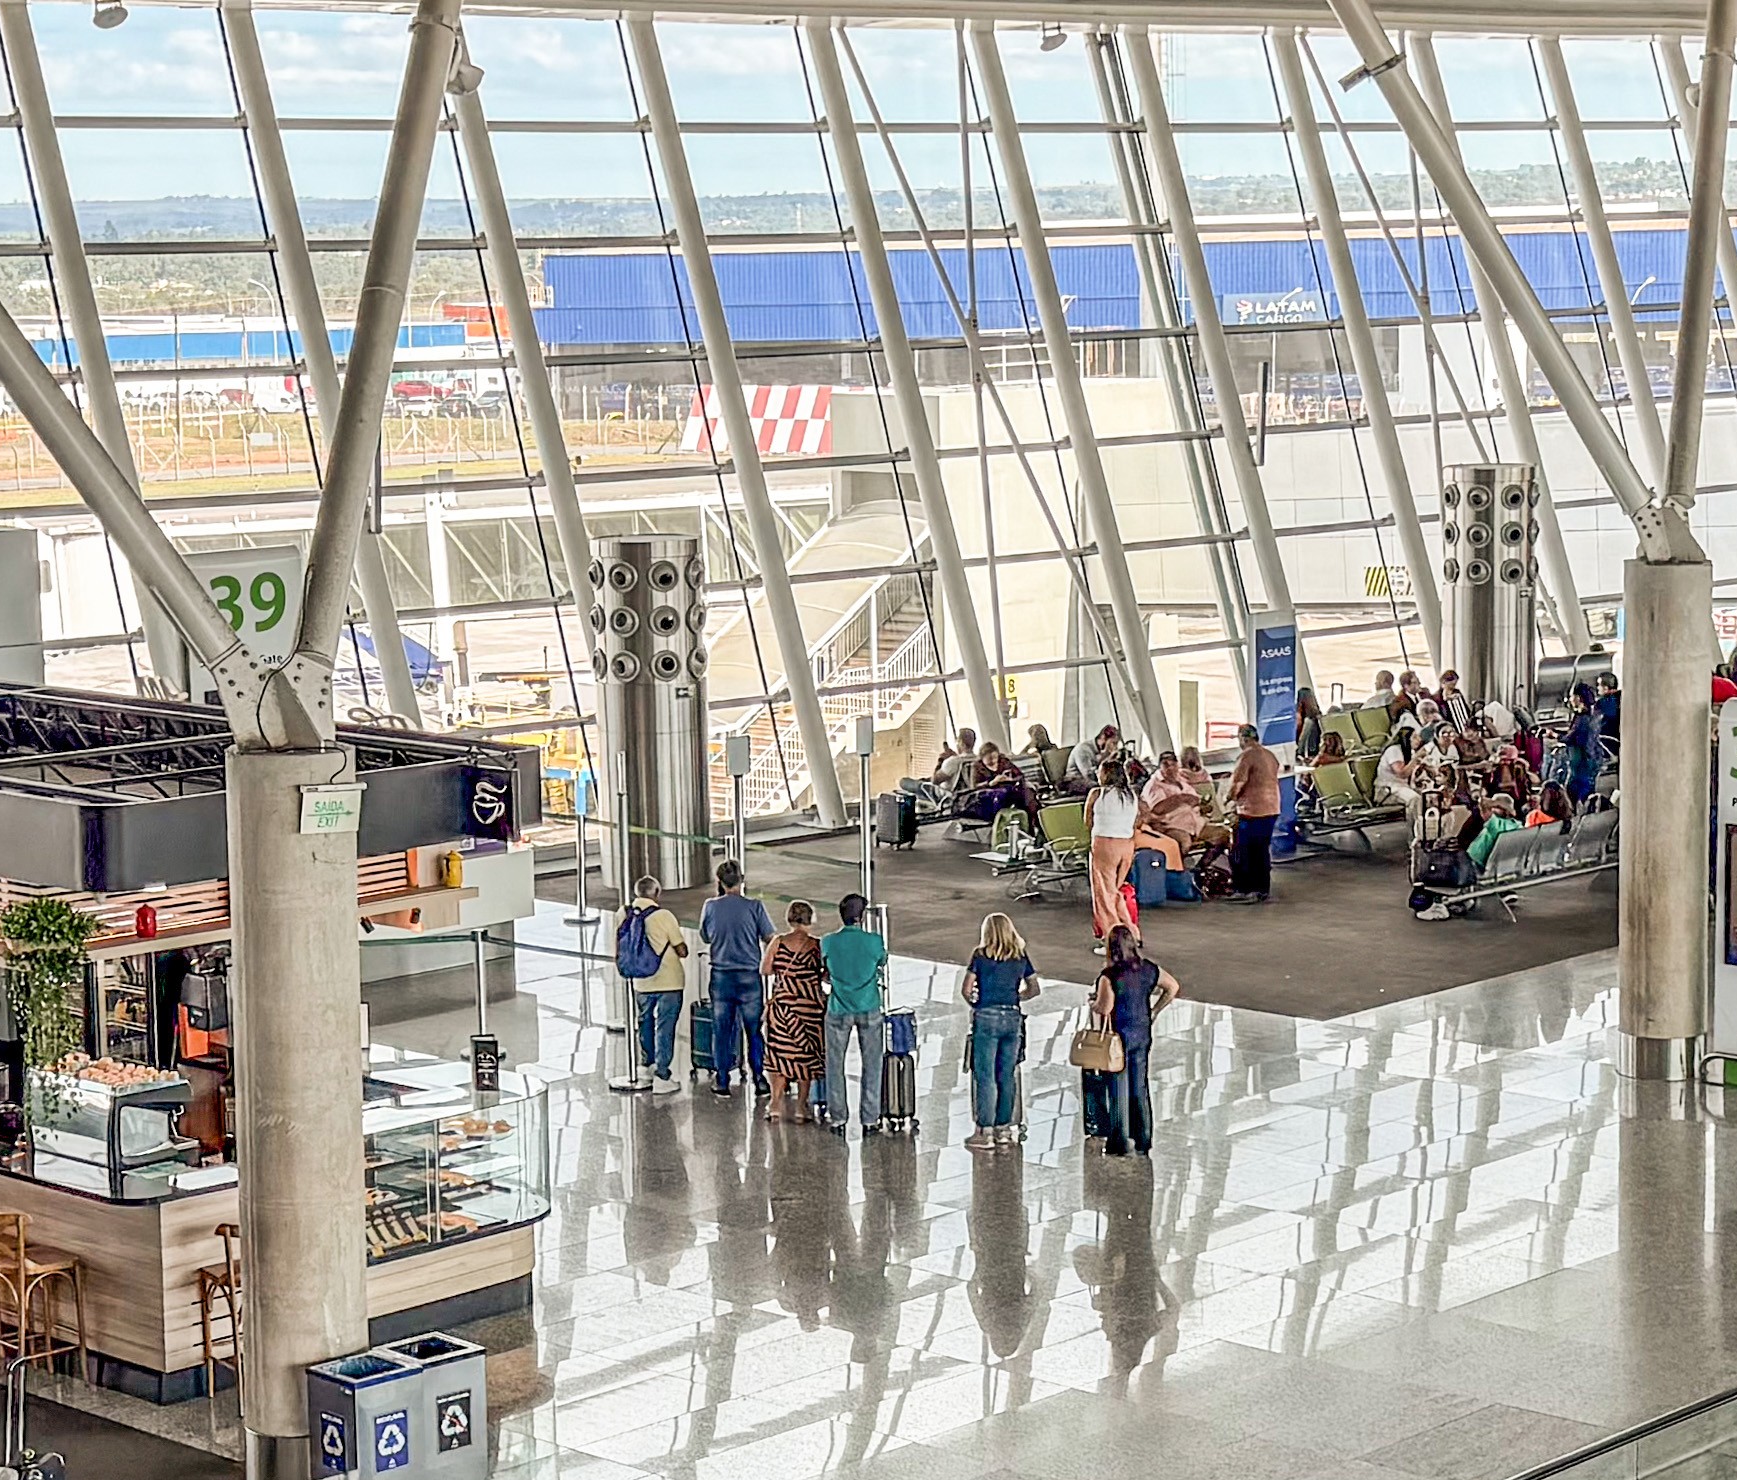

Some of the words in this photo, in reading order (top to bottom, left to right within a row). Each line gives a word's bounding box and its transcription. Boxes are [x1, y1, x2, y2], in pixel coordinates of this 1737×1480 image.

[1255, 300, 1317, 313] LATAM
[1256, 314, 1303, 324] CARGO
[209, 572, 286, 633] 39
[1261, 646, 1291, 658] ASAAS
